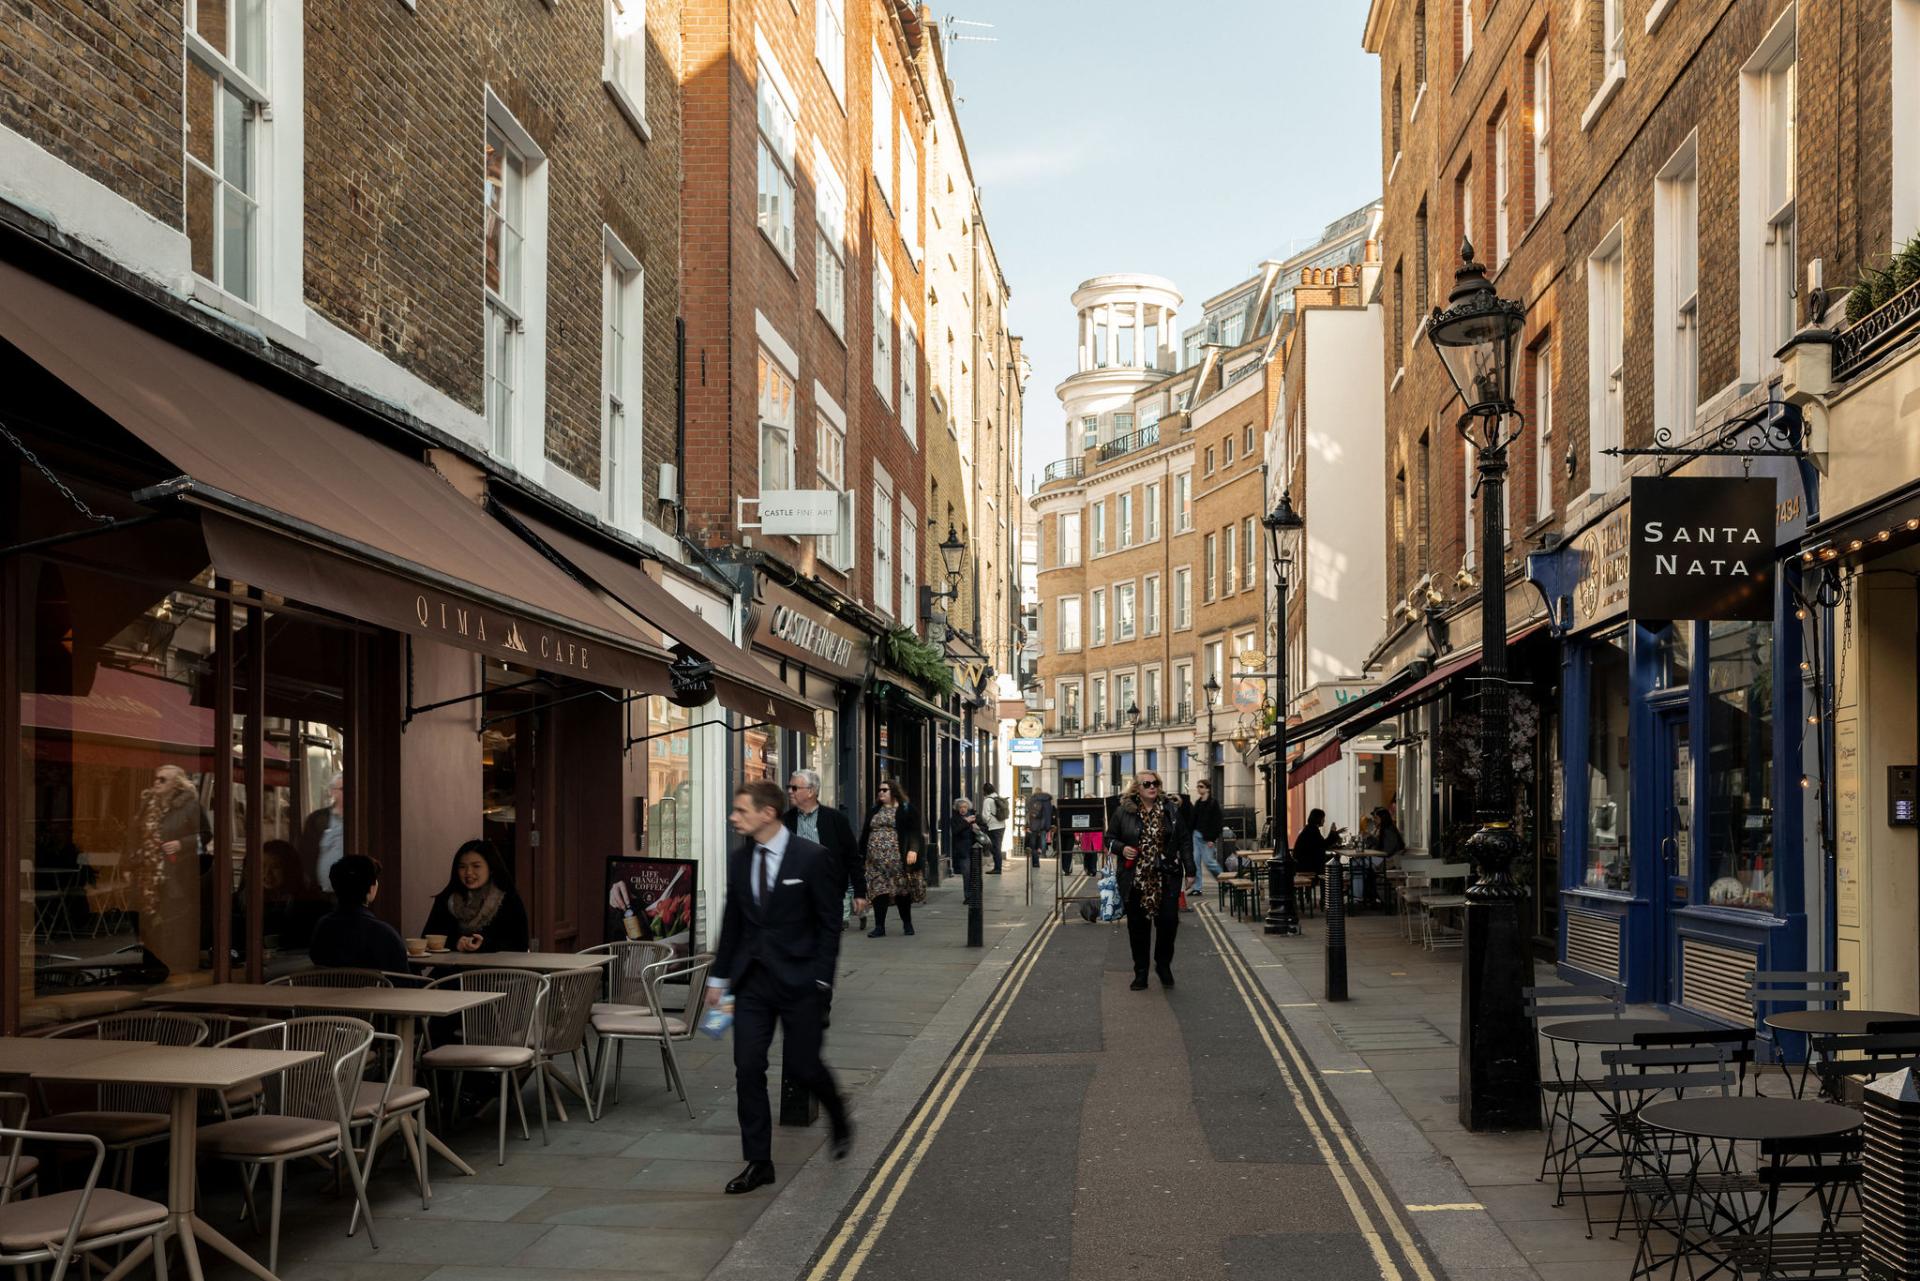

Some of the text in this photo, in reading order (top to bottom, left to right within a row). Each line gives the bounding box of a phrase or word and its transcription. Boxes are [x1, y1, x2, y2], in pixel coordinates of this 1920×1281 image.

[764, 509, 793, 517] CASTLE
[797, 509, 815, 517] FINE
[1644, 521, 1761, 544] SANTA
[1655, 554, 1749, 576] NATA
[416, 595, 588, 669] QIMA CAFE
[772, 605, 854, 668] CASTLE FINE ART
[630, 876, 669, 885] CHANGING
